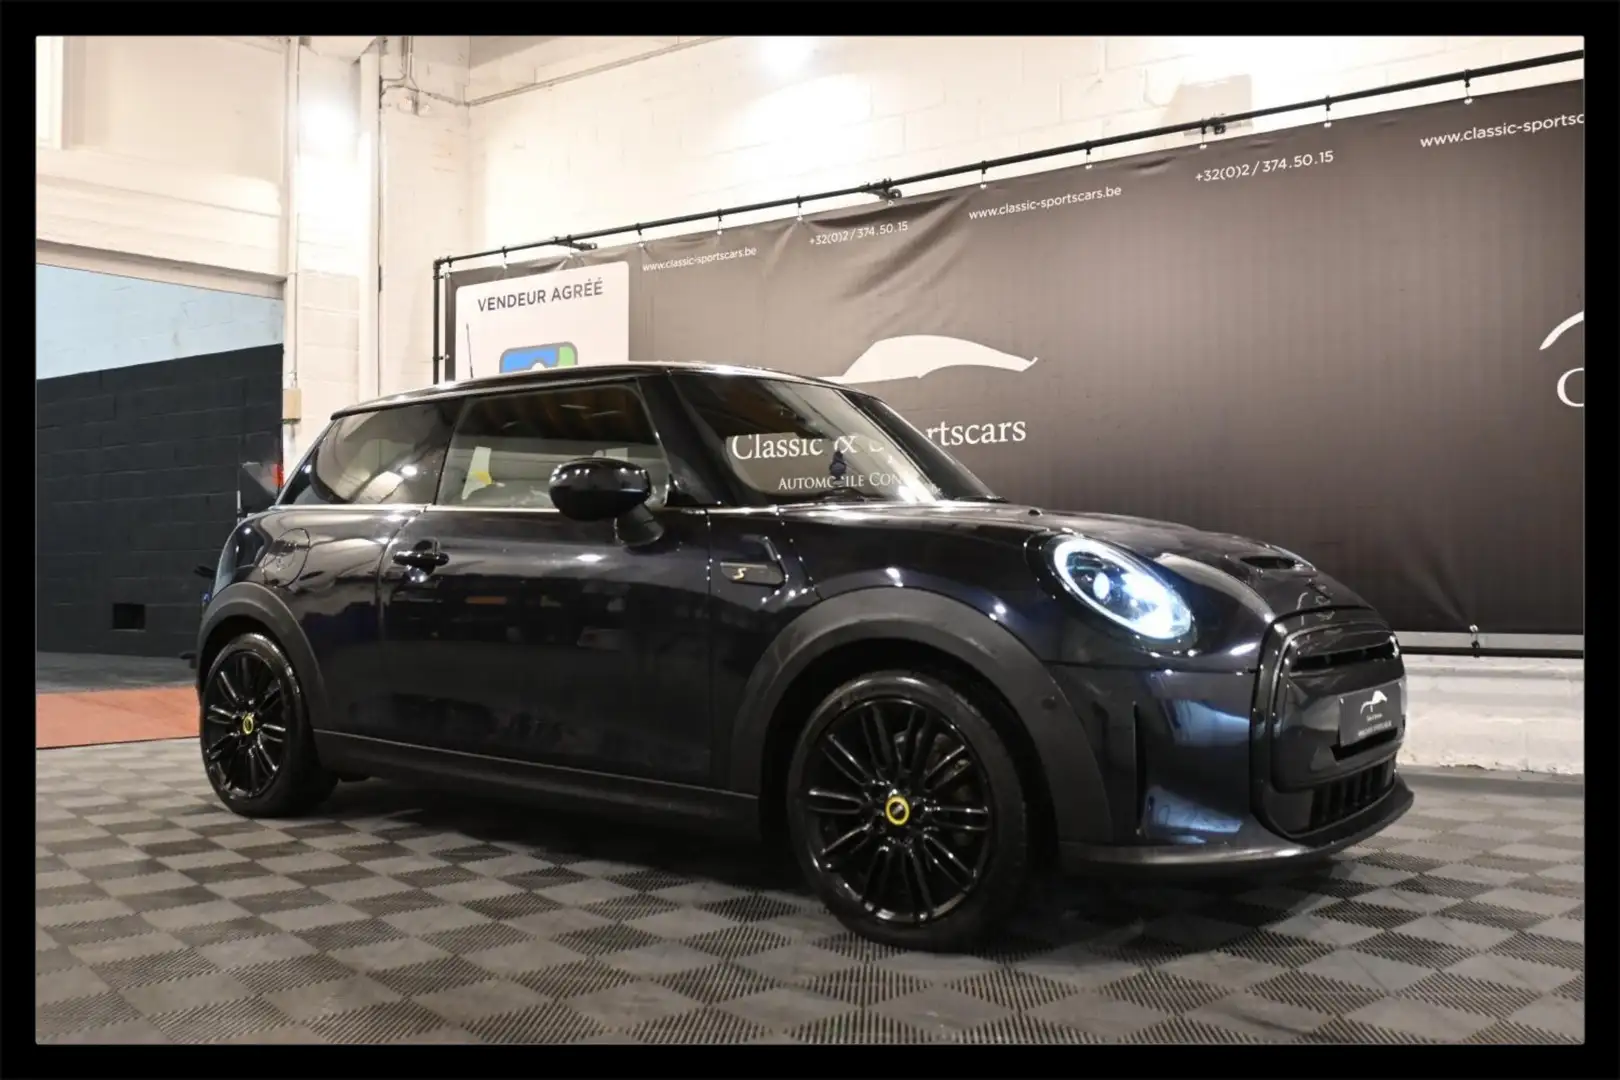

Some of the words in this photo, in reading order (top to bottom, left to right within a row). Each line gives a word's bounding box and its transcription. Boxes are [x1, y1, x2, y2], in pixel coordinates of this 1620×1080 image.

[968, 185, 1122, 220] www.classic-sportscars.be
[641, 246, 757, 273] www.classic-sportscars.be
[477, 289, 547, 312] VENDEUR
[551, 277, 604, 302] AGRÉÉ
[731, 433, 824, 460] Classic
[778, 475, 865, 491] AUTOMOILE
